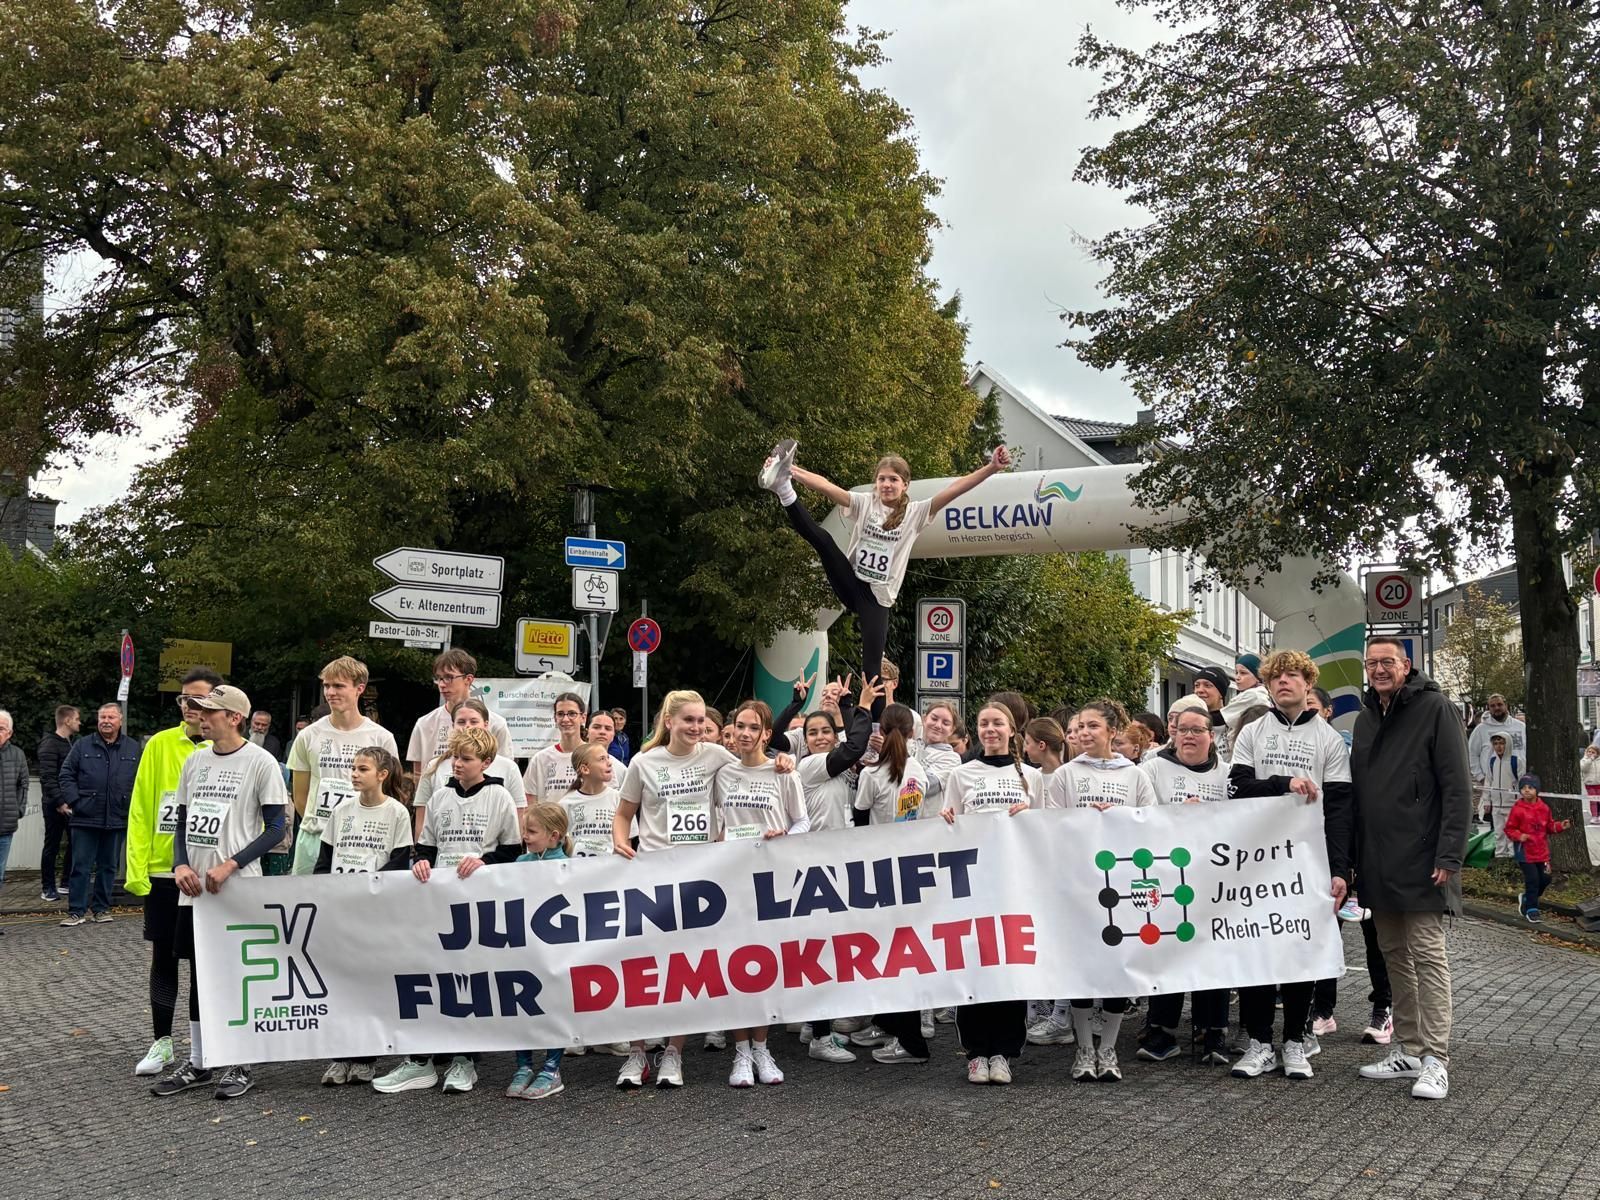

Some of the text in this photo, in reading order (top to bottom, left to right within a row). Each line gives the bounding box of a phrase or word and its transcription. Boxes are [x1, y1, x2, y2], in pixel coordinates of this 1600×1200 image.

[945, 502, 1053, 530] BELKAW
[948, 532, 1035, 543] Im Herzen bergisch.
[569, 548, 609, 557] Einbahnstraße
[859, 549, 889, 572] 218
[431, 563, 484, 580] Sportplatz
[1384, 584, 1405, 601] 20
[400, 597, 486, 616] Ev. Altenzentrum
[933, 613, 949, 626] 20
[1381, 611, 1409, 620] ZONE
[374, 624, 440, 639] Pastor-Löh-Str.
[529, 629, 565, 645] Netto
[930, 633, 951, 641] ZONE
[933, 656, 948, 676] P
[929, 680, 950, 688] ZONE
[660, 782, 685, 790] JUGEND
[189, 814, 221, 835] 320
[671, 813, 708, 832] 266
[1210, 839, 1295, 872] Sport
[1211, 872, 1305, 908] Jugend
[438, 848, 980, 951] JUGEND LÄUFT
[1211, 912, 1312, 941] Rhein-Berg
[394, 913, 1038, 1020] FÜR DEMOKRATIE
[253, 1003, 329, 1019] FAIREINS
[254, 1017, 320, 1033] KULTUR
